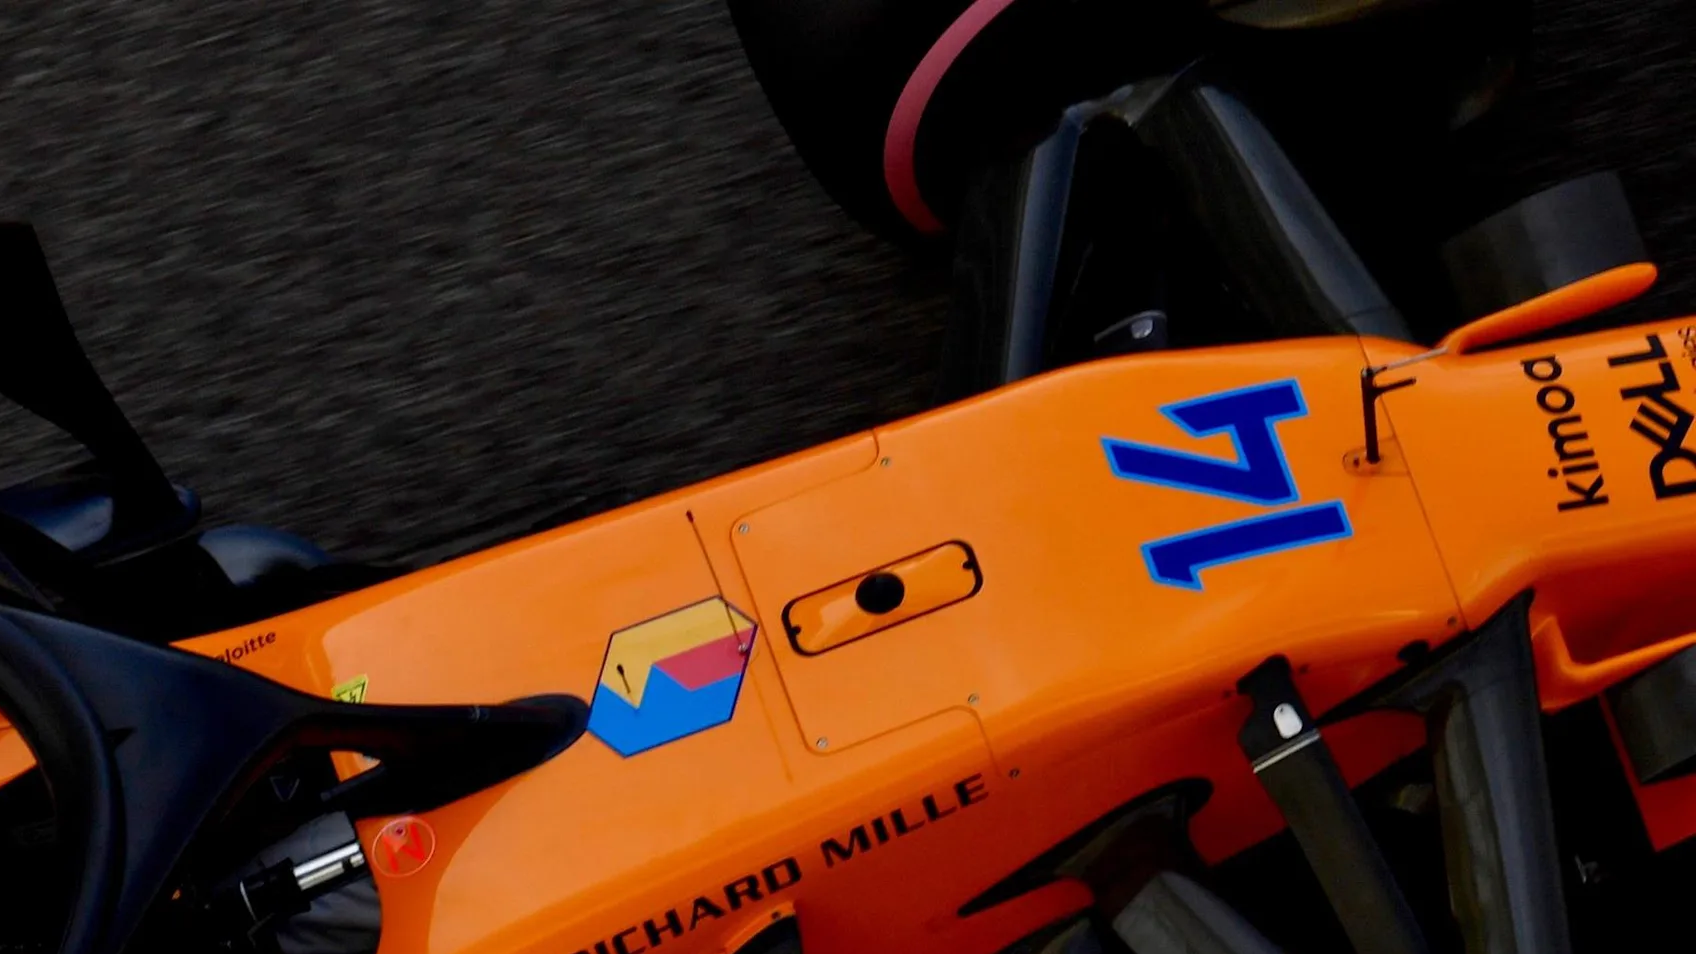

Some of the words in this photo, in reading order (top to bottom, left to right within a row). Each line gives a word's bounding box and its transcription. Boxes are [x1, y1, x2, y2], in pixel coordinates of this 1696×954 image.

[1100, 376, 1353, 592] 14
[1520, 355, 1609, 512] kimoa
[1607, 334, 1696, 499] DELL
[820, 772, 990, 867] MILLE
